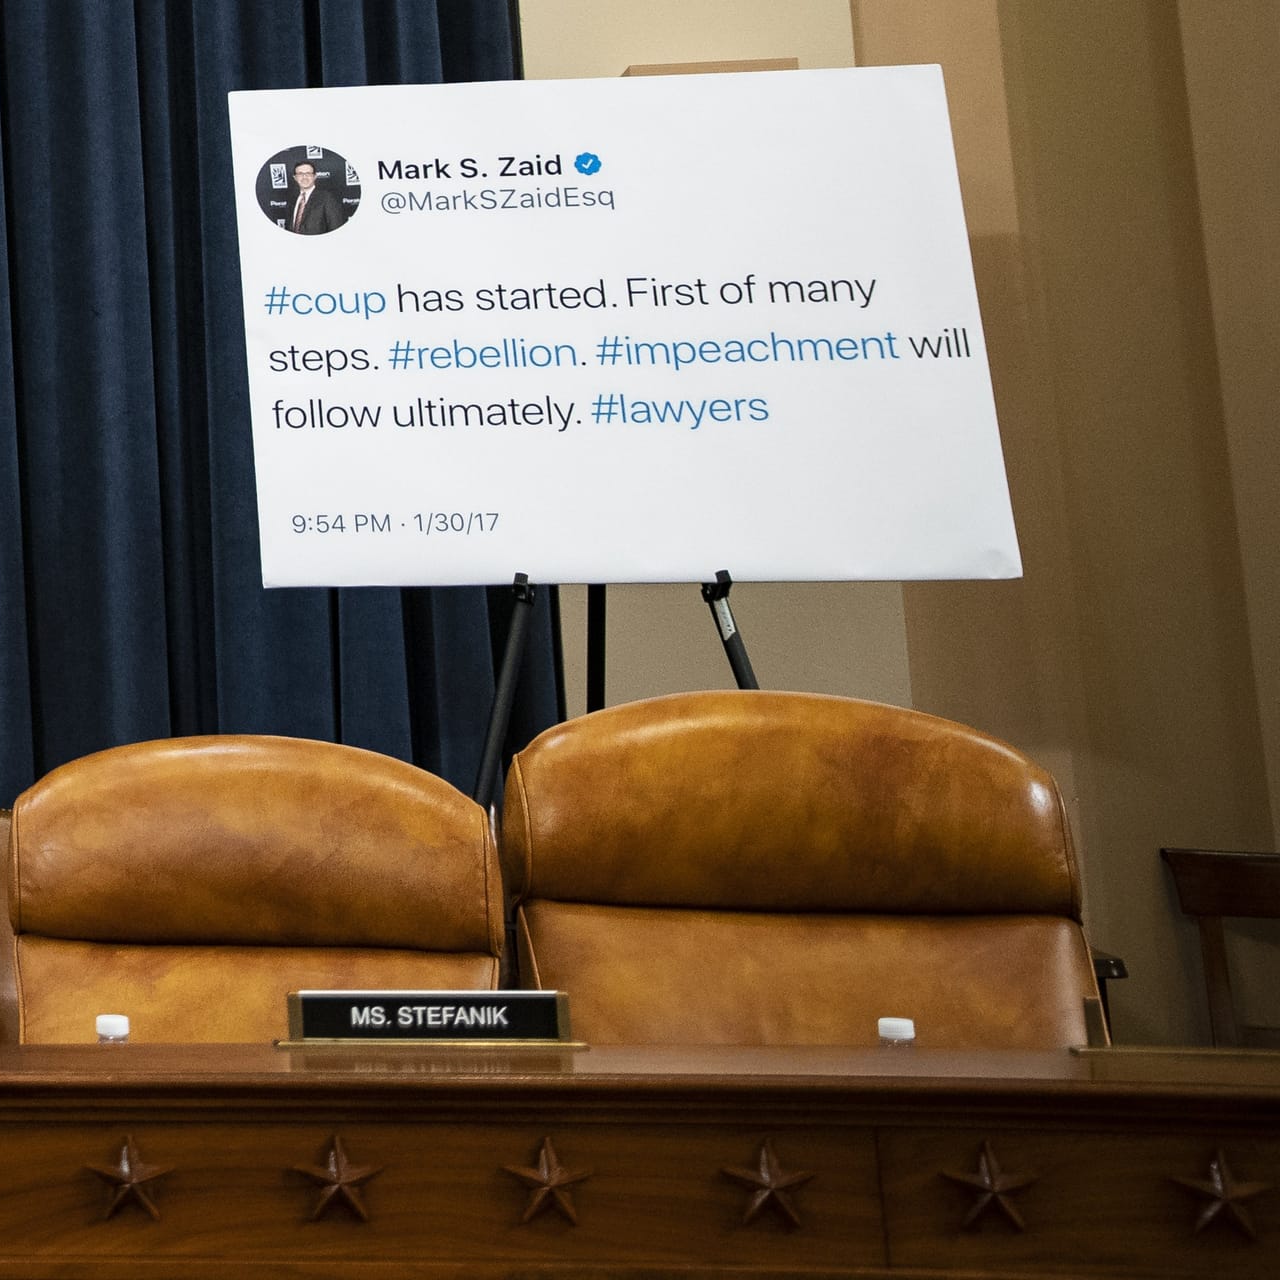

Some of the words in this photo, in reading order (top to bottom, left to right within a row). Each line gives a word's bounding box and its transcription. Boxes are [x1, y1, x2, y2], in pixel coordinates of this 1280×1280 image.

[377, 158, 452, 180] Mark
[459, 158, 488, 179] S.
[498, 154, 562, 177] Zaid
[381, 186, 615, 215] @MarkSZaidEsq
[263, 285, 386, 321] #coup
[397, 283, 465, 313] has
[475, 278, 617, 311] started.
[626, 277, 710, 308] First
[719, 273, 756, 305] of
[768, 279, 876, 309] many
[269, 345, 379, 378] steps.
[388, 338, 587, 370] #rebellion.
[595, 331, 900, 371] #impeachment
[908, 327, 971, 359] will
[271, 398, 382, 429] follow
[392, 395, 582, 433] ultimately.
[591, 393, 769, 430] #lawyers
[291, 514, 347, 534] 9:54
[354, 513, 391, 533] PM
[413, 512, 499, 536] 1/30/17
[351, 1006, 391, 1025] MS.
[397, 1006, 508, 1025] STEFANIK
